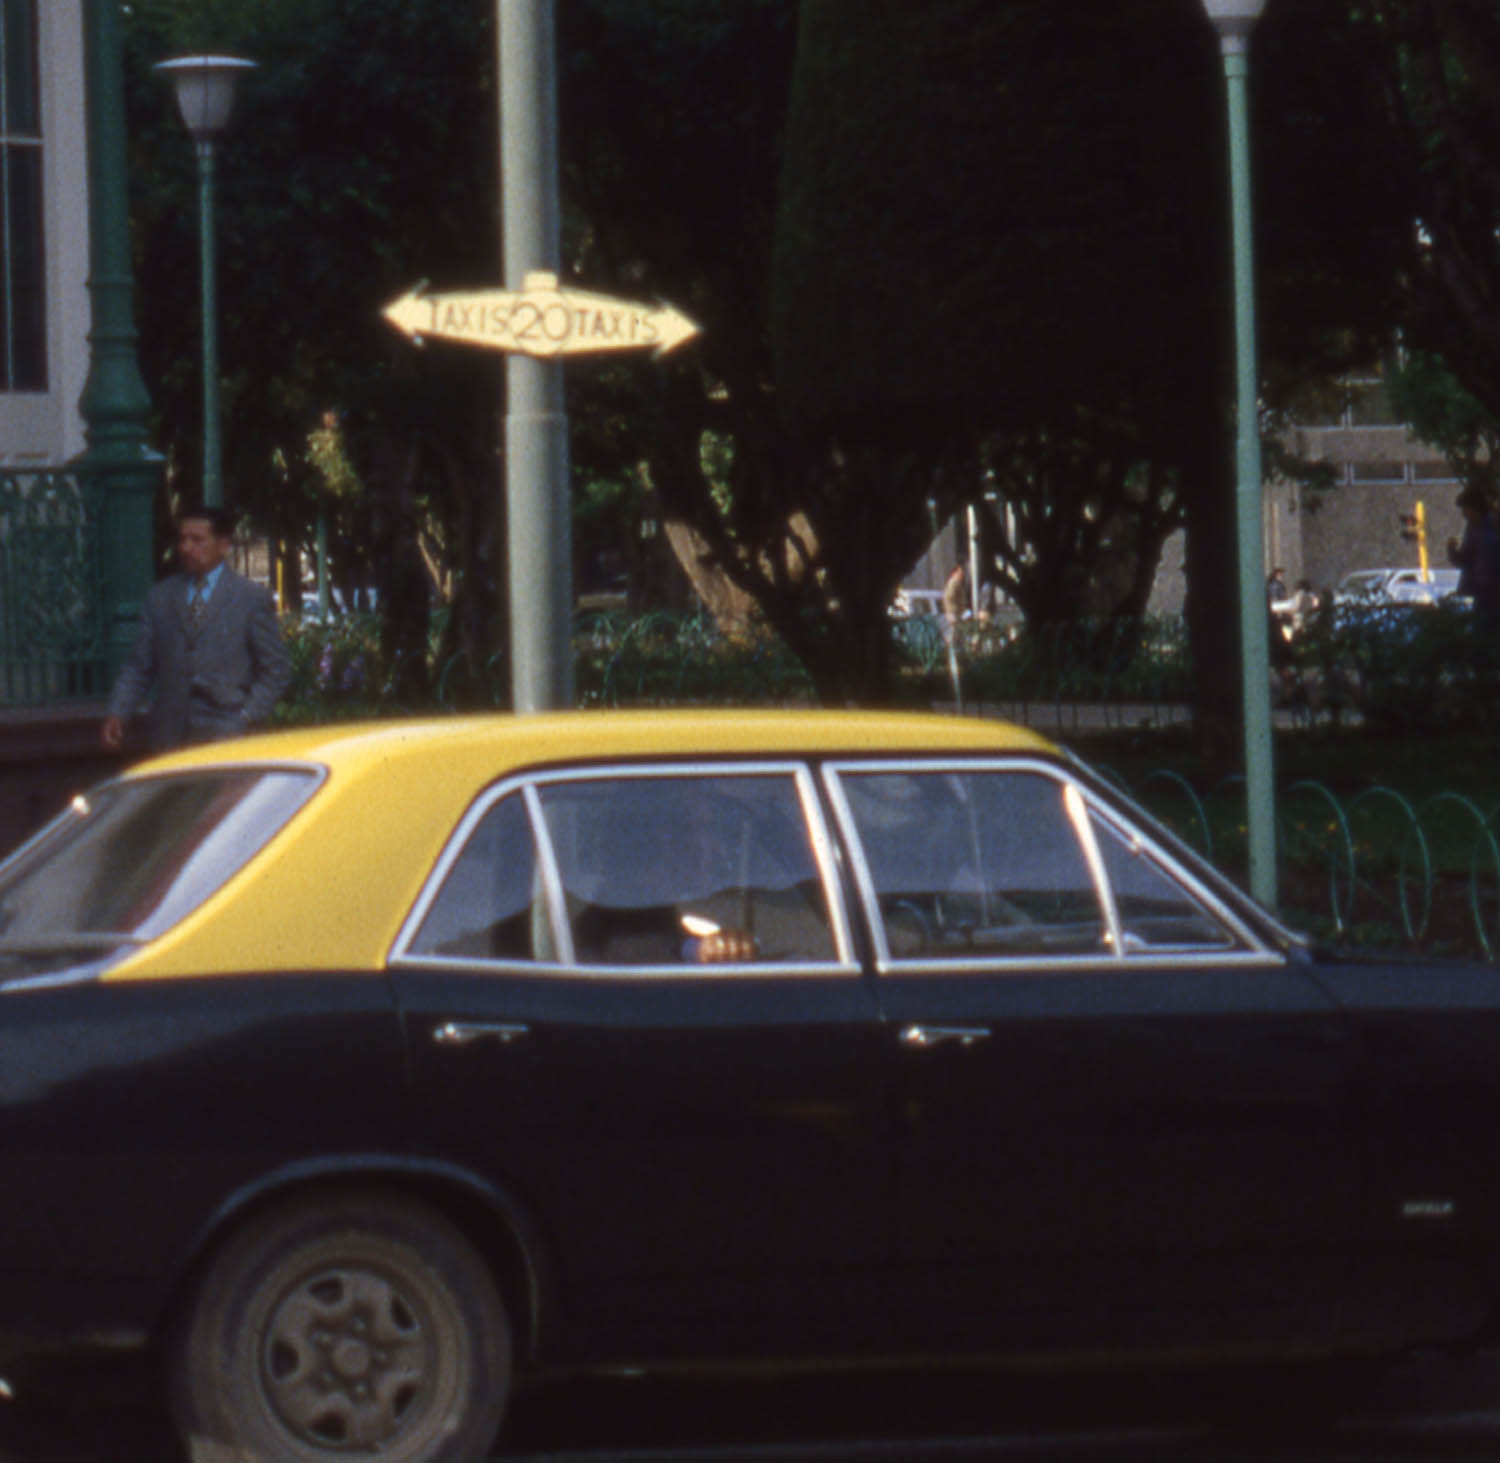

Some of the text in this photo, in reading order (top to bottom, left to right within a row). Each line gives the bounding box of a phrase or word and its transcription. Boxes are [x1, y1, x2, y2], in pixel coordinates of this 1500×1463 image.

[430, 298, 659, 341] TAXIS 20 TAXIS
